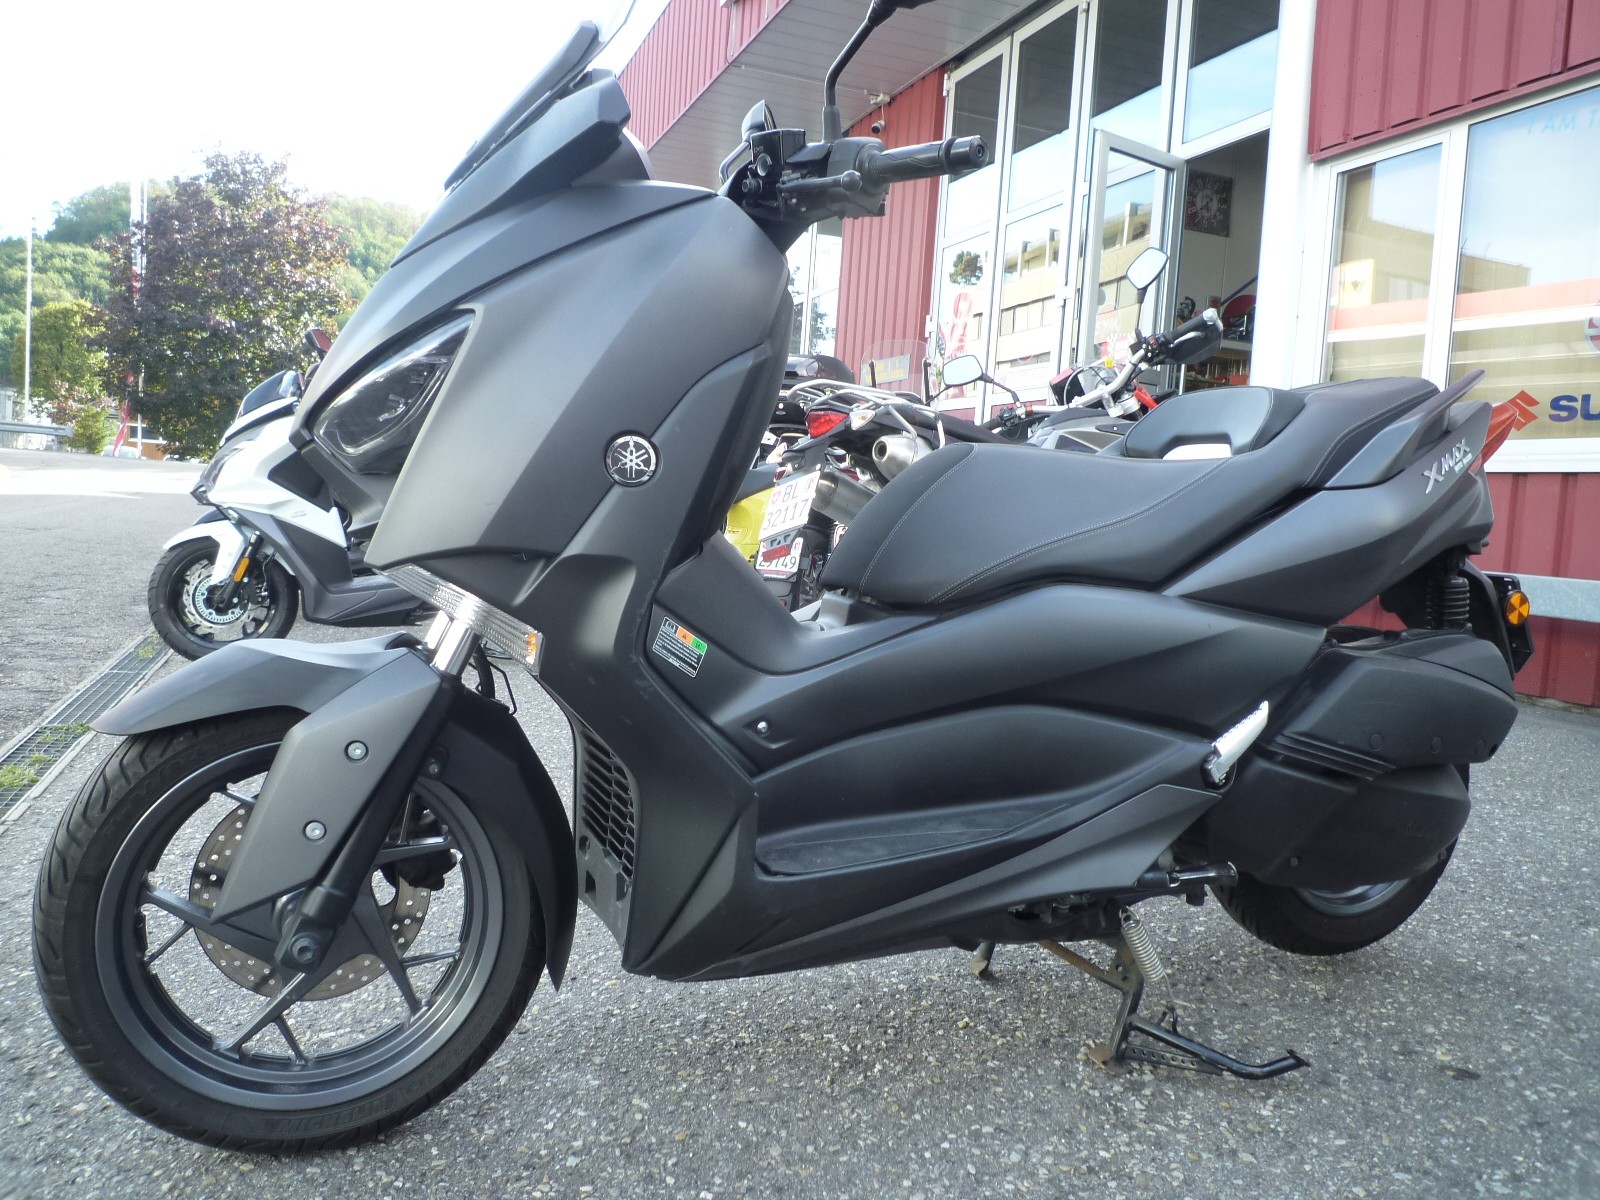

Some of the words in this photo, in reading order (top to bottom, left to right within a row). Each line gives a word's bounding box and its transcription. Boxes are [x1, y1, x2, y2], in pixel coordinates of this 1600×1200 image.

[1548, 393, 1600, 422] SU
[783, 482, 799, 503] BL
[763, 499, 809, 531] 32117
